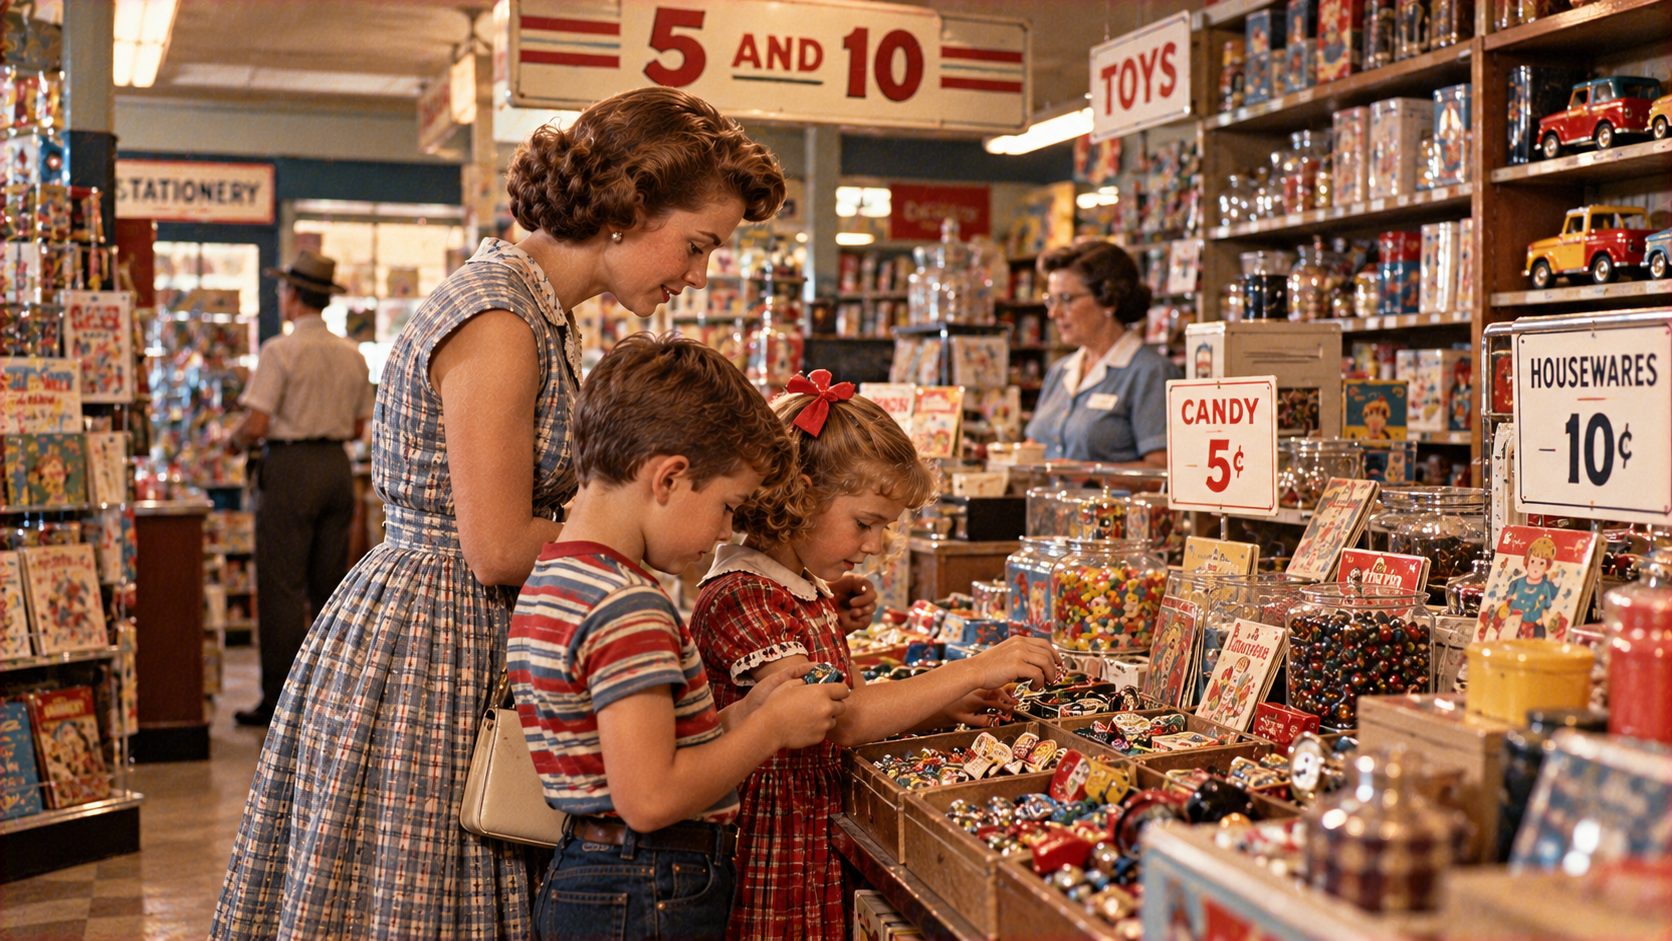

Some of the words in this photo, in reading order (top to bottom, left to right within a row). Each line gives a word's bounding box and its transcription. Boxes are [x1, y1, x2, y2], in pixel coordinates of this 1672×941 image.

[643, 6, 707, 89] 5
[732, 33, 824, 73] AND
[843, 26, 924, 103] 10
[1101, 41, 1177, 117] TOYS
[115, 177, 260, 206] STATIONERY
[1530, 353, 1658, 389] HOUSEWARES
[1181, 397, 1260, 426] CANDY
[1205, 438, 1245, 493] 5¢
[1565, 411, 1632, 487] 10¢
